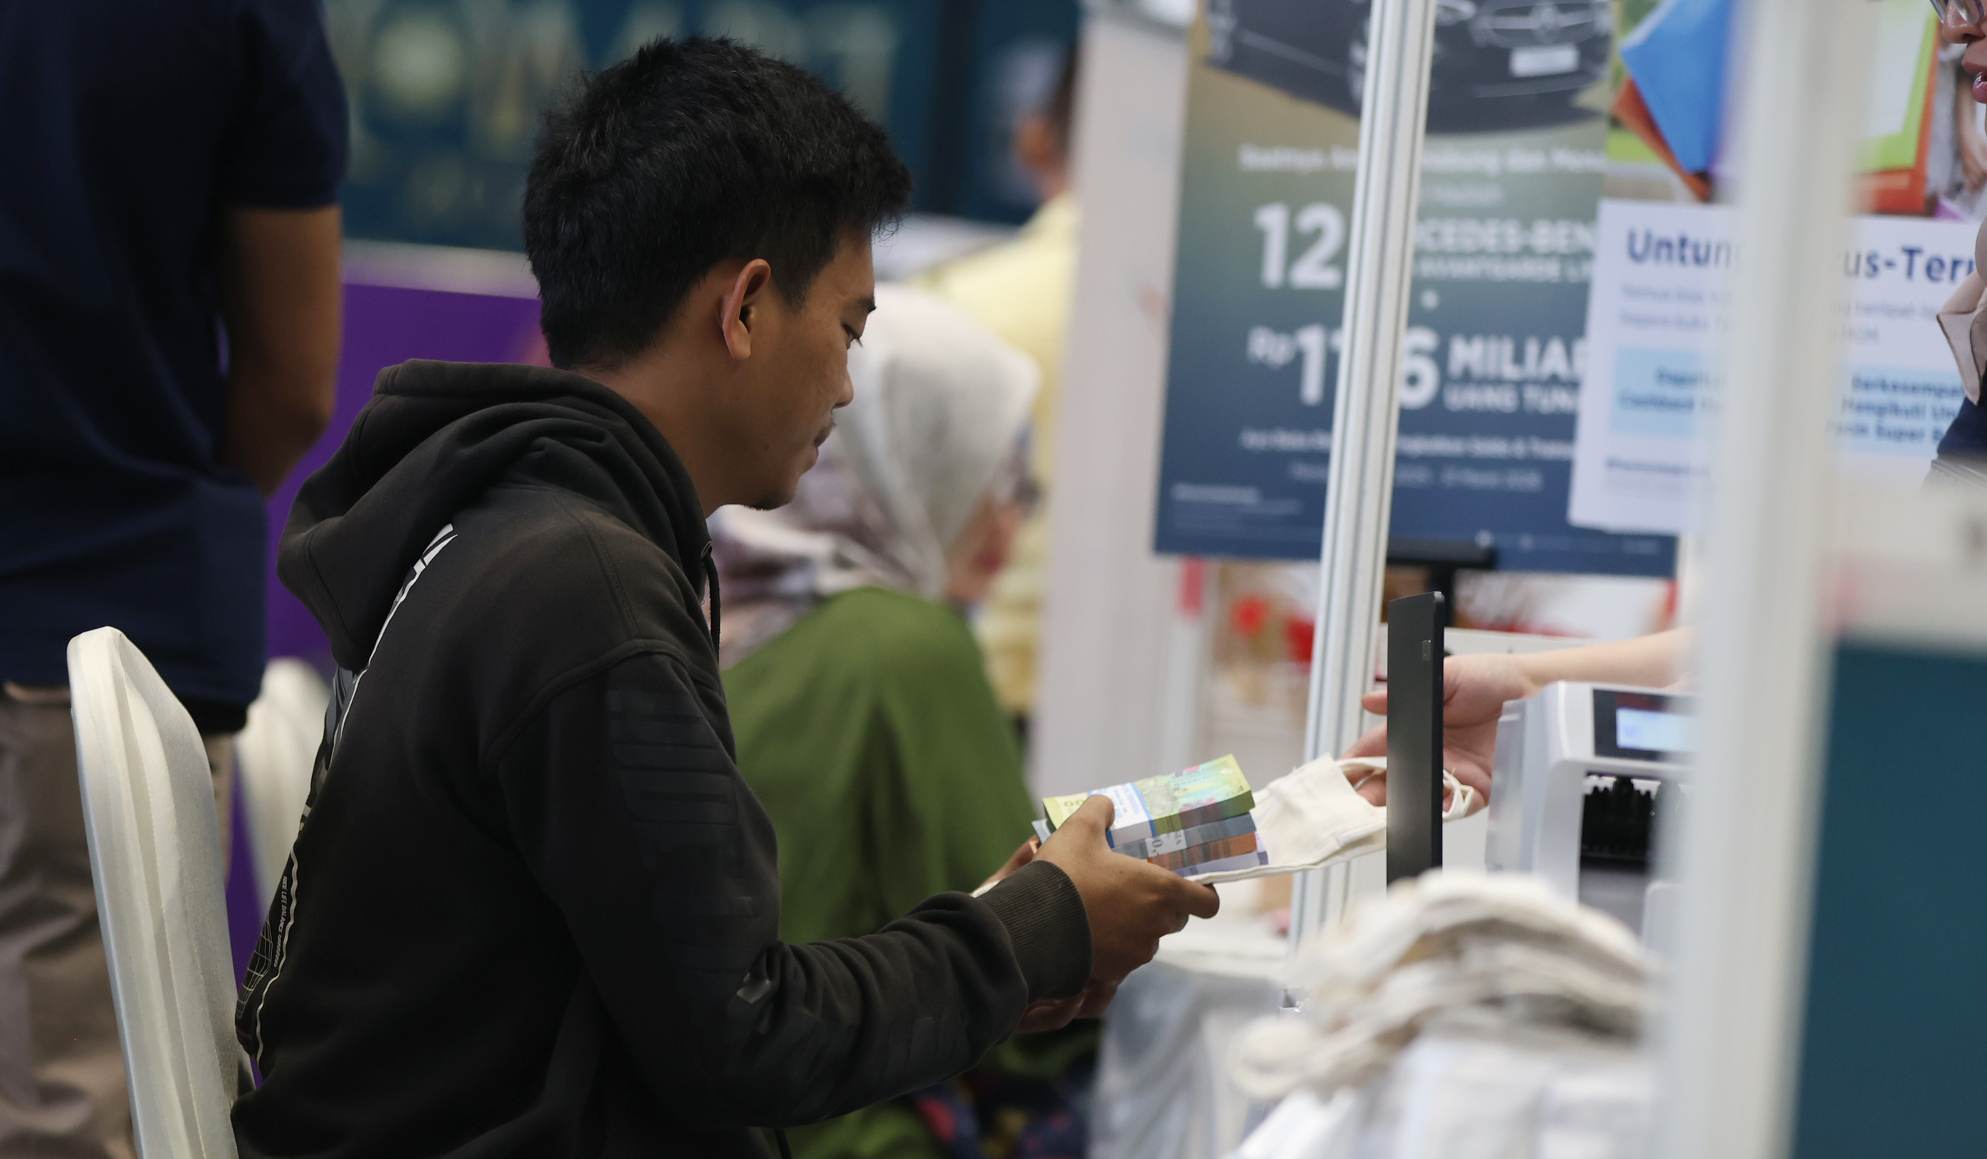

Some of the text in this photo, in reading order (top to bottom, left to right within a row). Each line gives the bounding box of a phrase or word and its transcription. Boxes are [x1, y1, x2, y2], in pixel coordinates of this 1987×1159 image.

[1252, 203, 1346, 289] 12
[1416, 219, 1595, 254] CEDES-BEN
[1627, 227, 1738, 272] Untun
[1842, 245, 1976, 282] us-Ter
[1522, 385, 1580, 415] TUN
